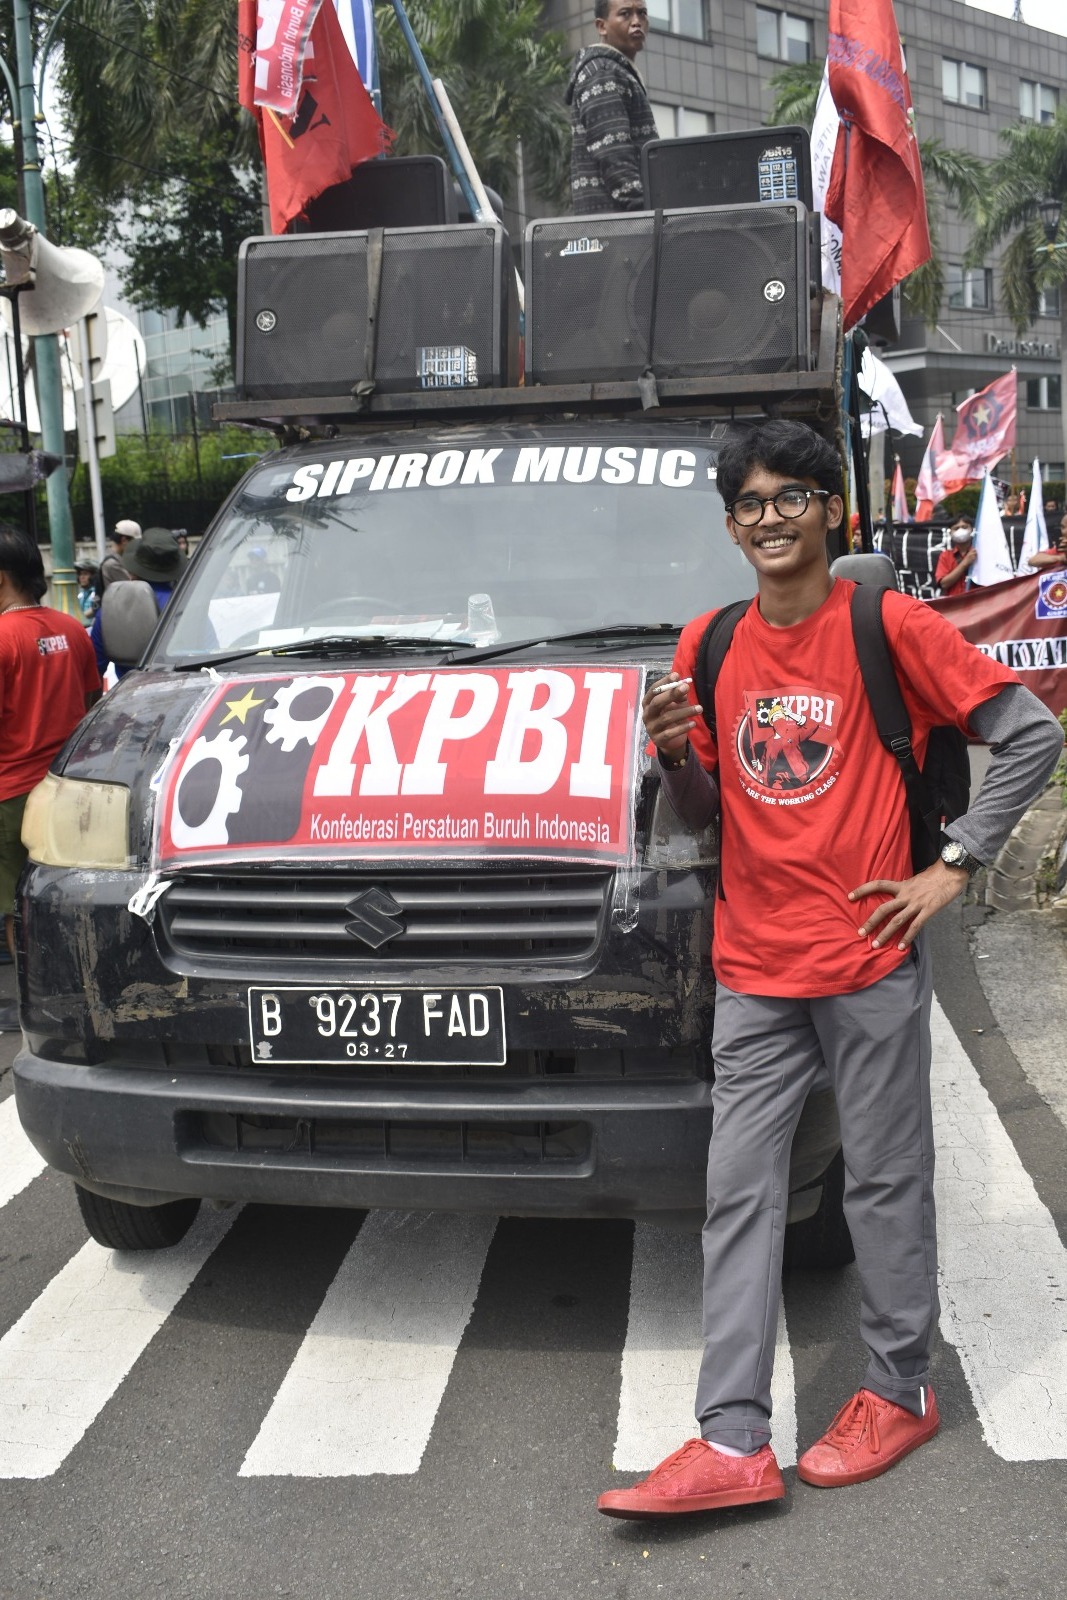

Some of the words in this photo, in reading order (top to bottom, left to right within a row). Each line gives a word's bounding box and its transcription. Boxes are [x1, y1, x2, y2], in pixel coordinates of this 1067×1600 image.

[286, 448, 503, 502] SIPIROK
[512, 446, 697, 488] MUSIC
[781, 695, 834, 727] KPBI
[313, 668, 623, 799] KPBI
[745, 788, 760, 800] ARE
[761, 794, 777, 805] THE
[778, 793, 815, 806] WORKING
[815, 775, 837, 796] CLASS
[310, 813, 398, 840] Konfederasi
[402, 815, 479, 839] Persatuan
[484, 812, 530, 839] Buruh
[535, 813, 611, 844] Indonesia
[261, 993, 282, 1037] B
[316, 993, 402, 1037] 9237
[422, 993, 490, 1037] FAD
